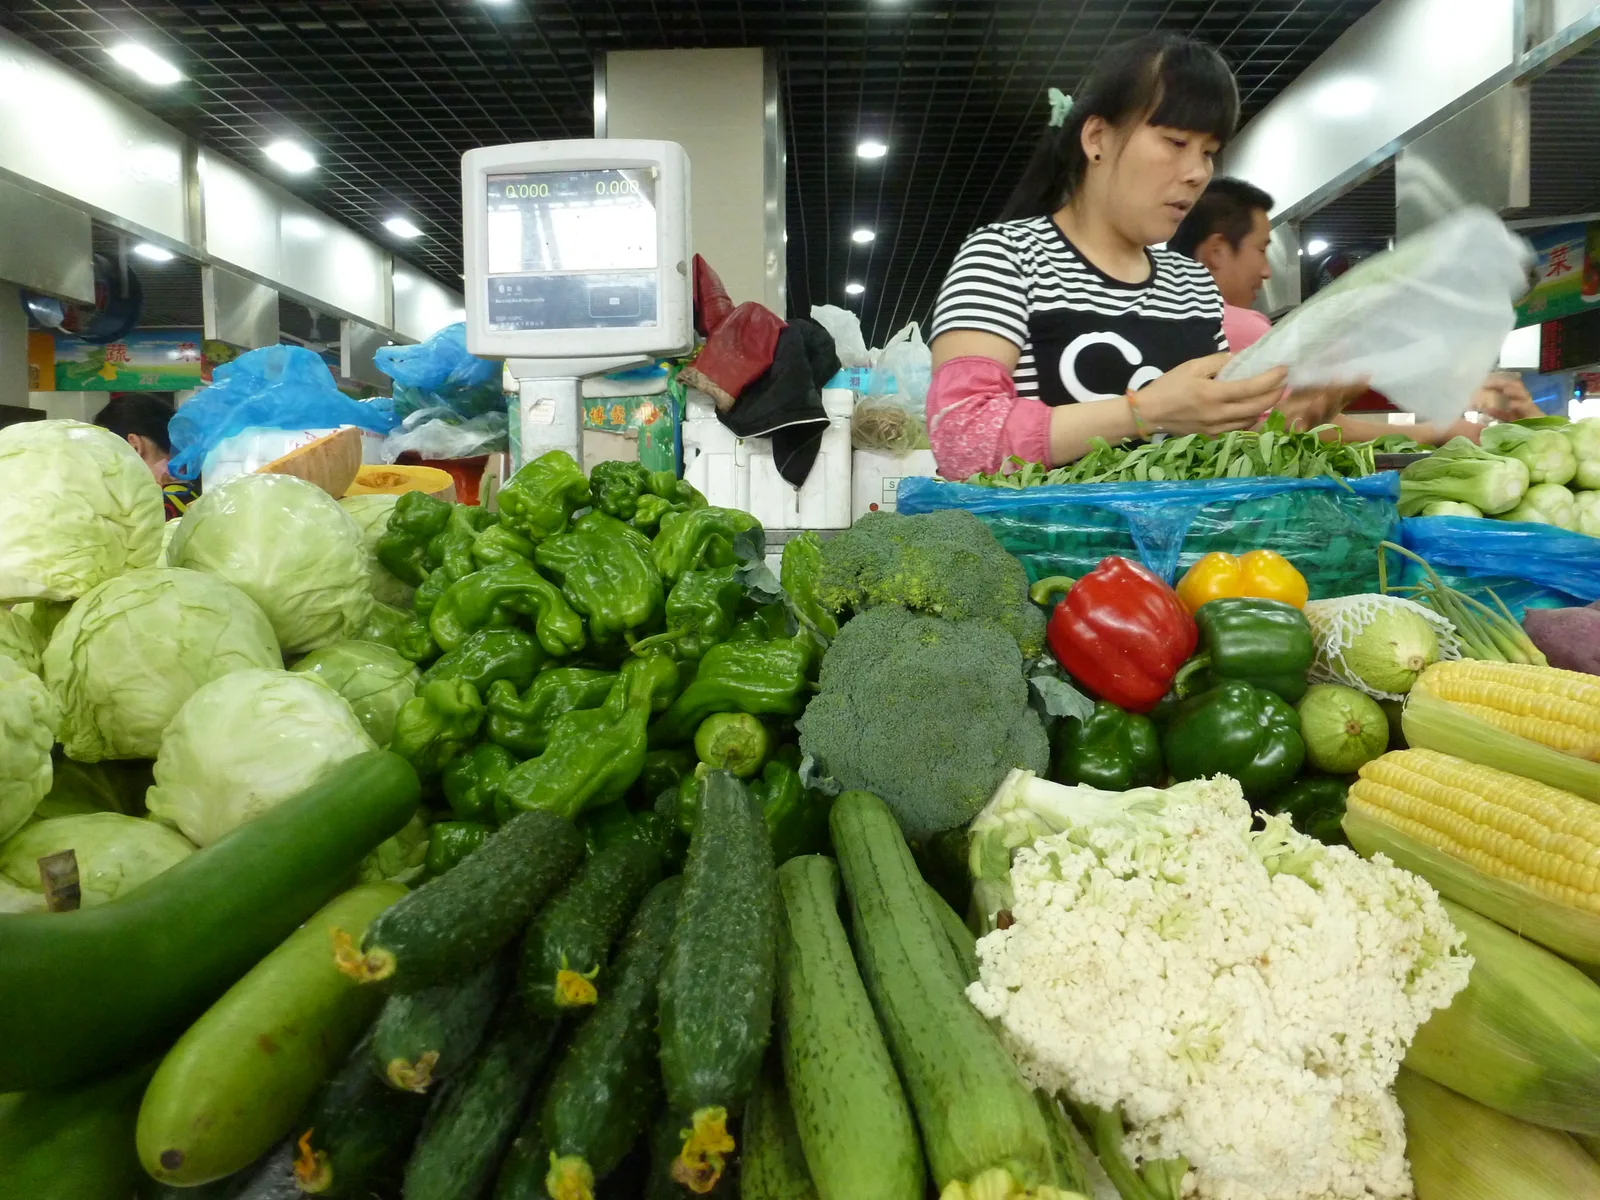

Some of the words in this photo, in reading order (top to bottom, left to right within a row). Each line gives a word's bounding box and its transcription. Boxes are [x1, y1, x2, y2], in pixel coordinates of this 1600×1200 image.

[506, 183, 549, 199] 0.000
[596, 179, 639, 195] 0.000
[1546, 247, 1572, 276] 菜
[889, 480, 896, 489] S
